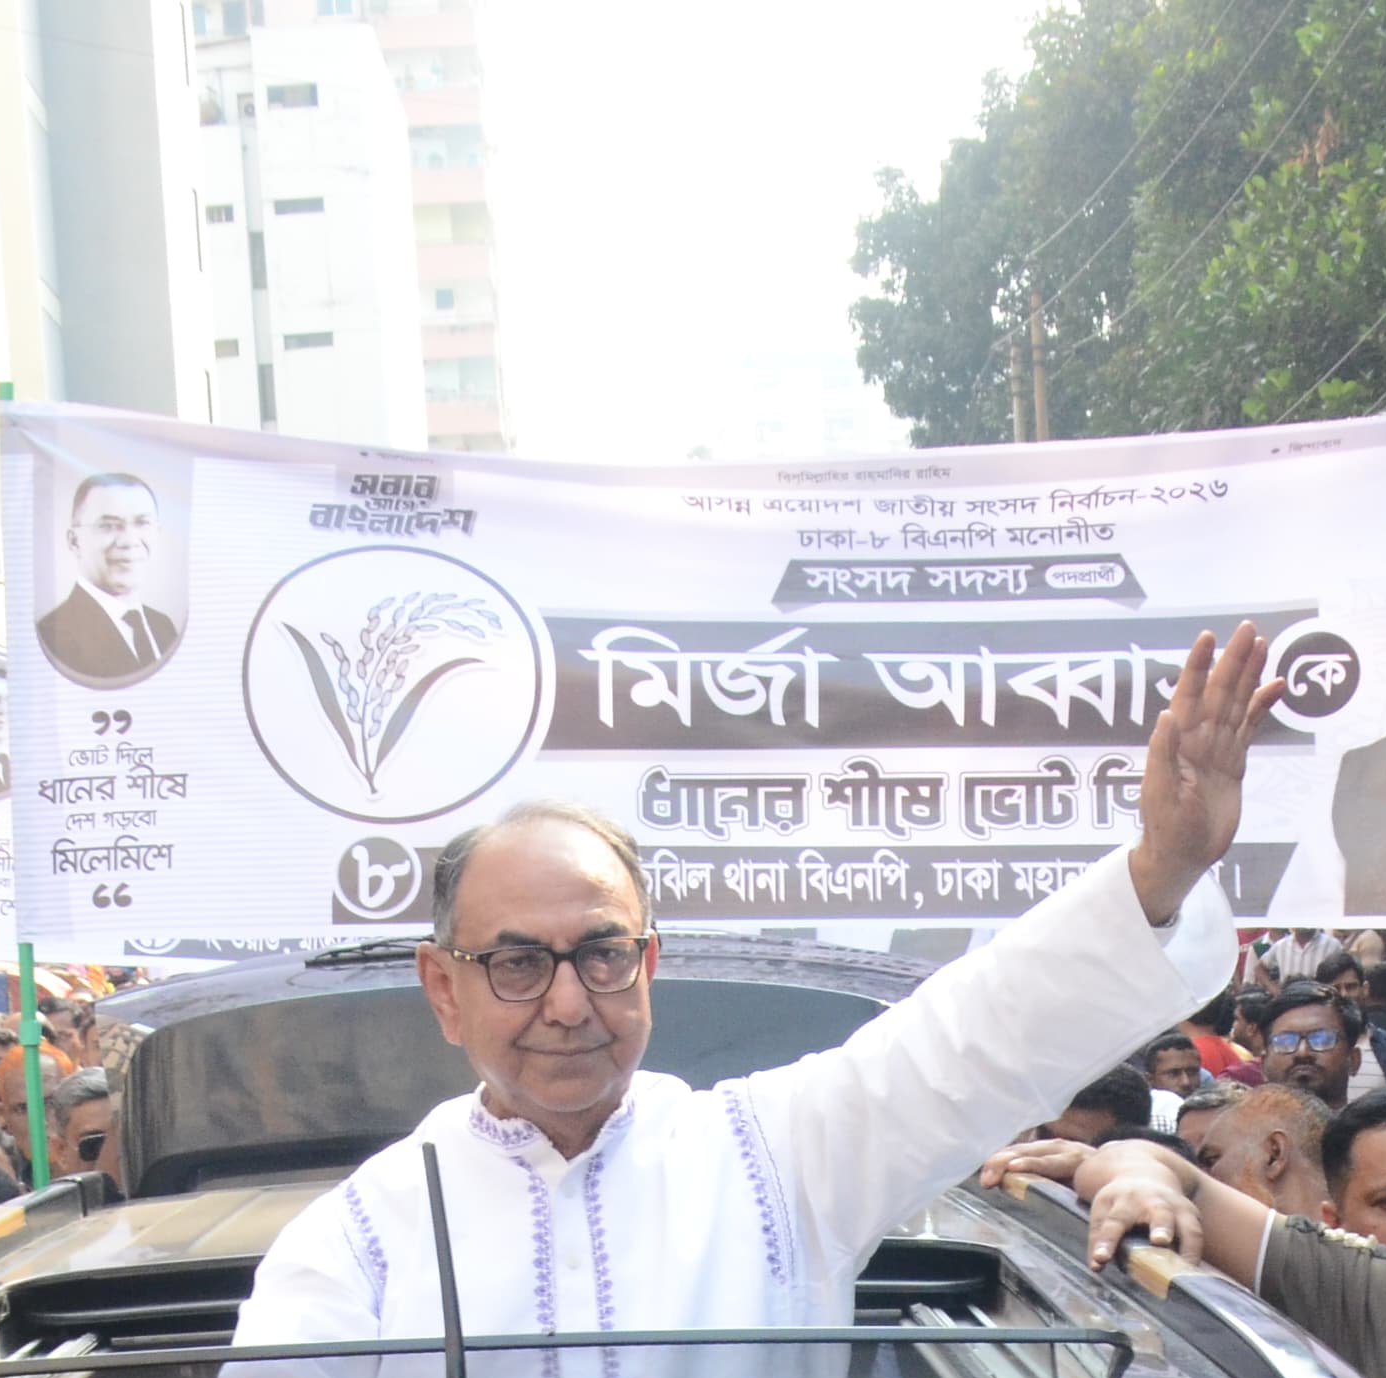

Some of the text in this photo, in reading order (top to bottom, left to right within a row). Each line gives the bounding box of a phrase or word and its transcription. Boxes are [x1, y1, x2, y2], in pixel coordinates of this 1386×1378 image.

[351, 473, 438, 499] সবার
[874, 494, 956, 518] জাতীয়
[966, 497, 1040, 518] সংসদ
[1050, 479, 1229, 514] নির্বাচন-২০২৬
[309, 503, 477, 537] বাংলাদেশ
[797, 516, 1117, 550] ঢাকা-৮ বিএনপি মনোনীত
[802, 566, 916, 598] সংসদ
[923, 564, 1035, 598] সদস্য
[577, 626, 840, 728] মির্জা
[1288, 652, 1353, 697] কে
[69, 741, 154, 767] ভোট দিলে
[38, 764, 189, 804] ধানের শীষে
[638, 765, 810, 840] ধানের
[820, 757, 948, 839] শীষে
[962, 756, 1079, 839] ভোট
[65, 812, 96, 831] দেশ
[50, 834, 175, 876] মিলেমিশে
[352, 844, 411, 909] ৮
[723, 857, 789, 902] থানা
[795, 848, 925, 909] বিএনপি,
[932, 858, 1003, 901] ঢাকা
